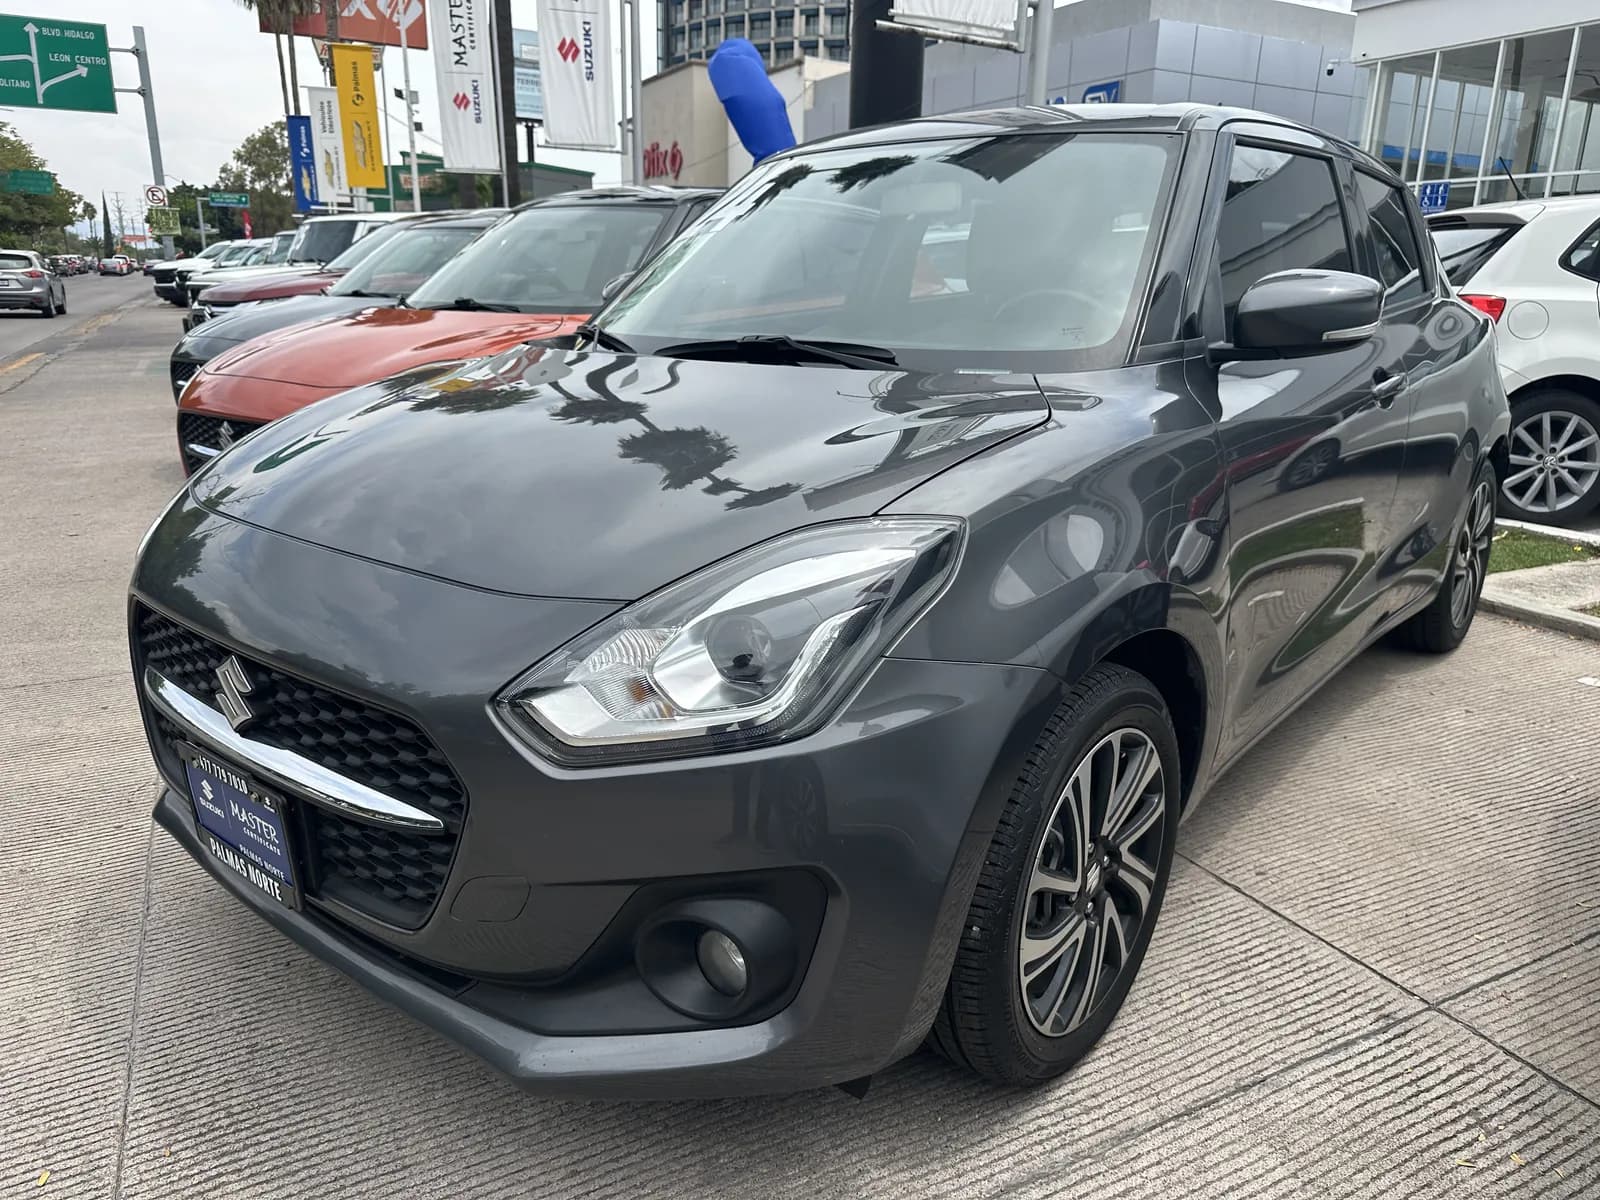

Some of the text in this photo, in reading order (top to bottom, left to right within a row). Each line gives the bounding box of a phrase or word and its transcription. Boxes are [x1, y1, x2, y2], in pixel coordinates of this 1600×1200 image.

[41, 27, 95, 40] BLVD HIDALGO
[582, 21, 594, 82] SUZUKI
[48, 53, 107, 66] LEON CENTRO
[471, 80, 482, 124] SUZUKI
[199, 796, 225, 819] SUZUKI
[229, 799, 280, 845] MASTER
[209, 837, 283, 902] PALMAS NORTE
